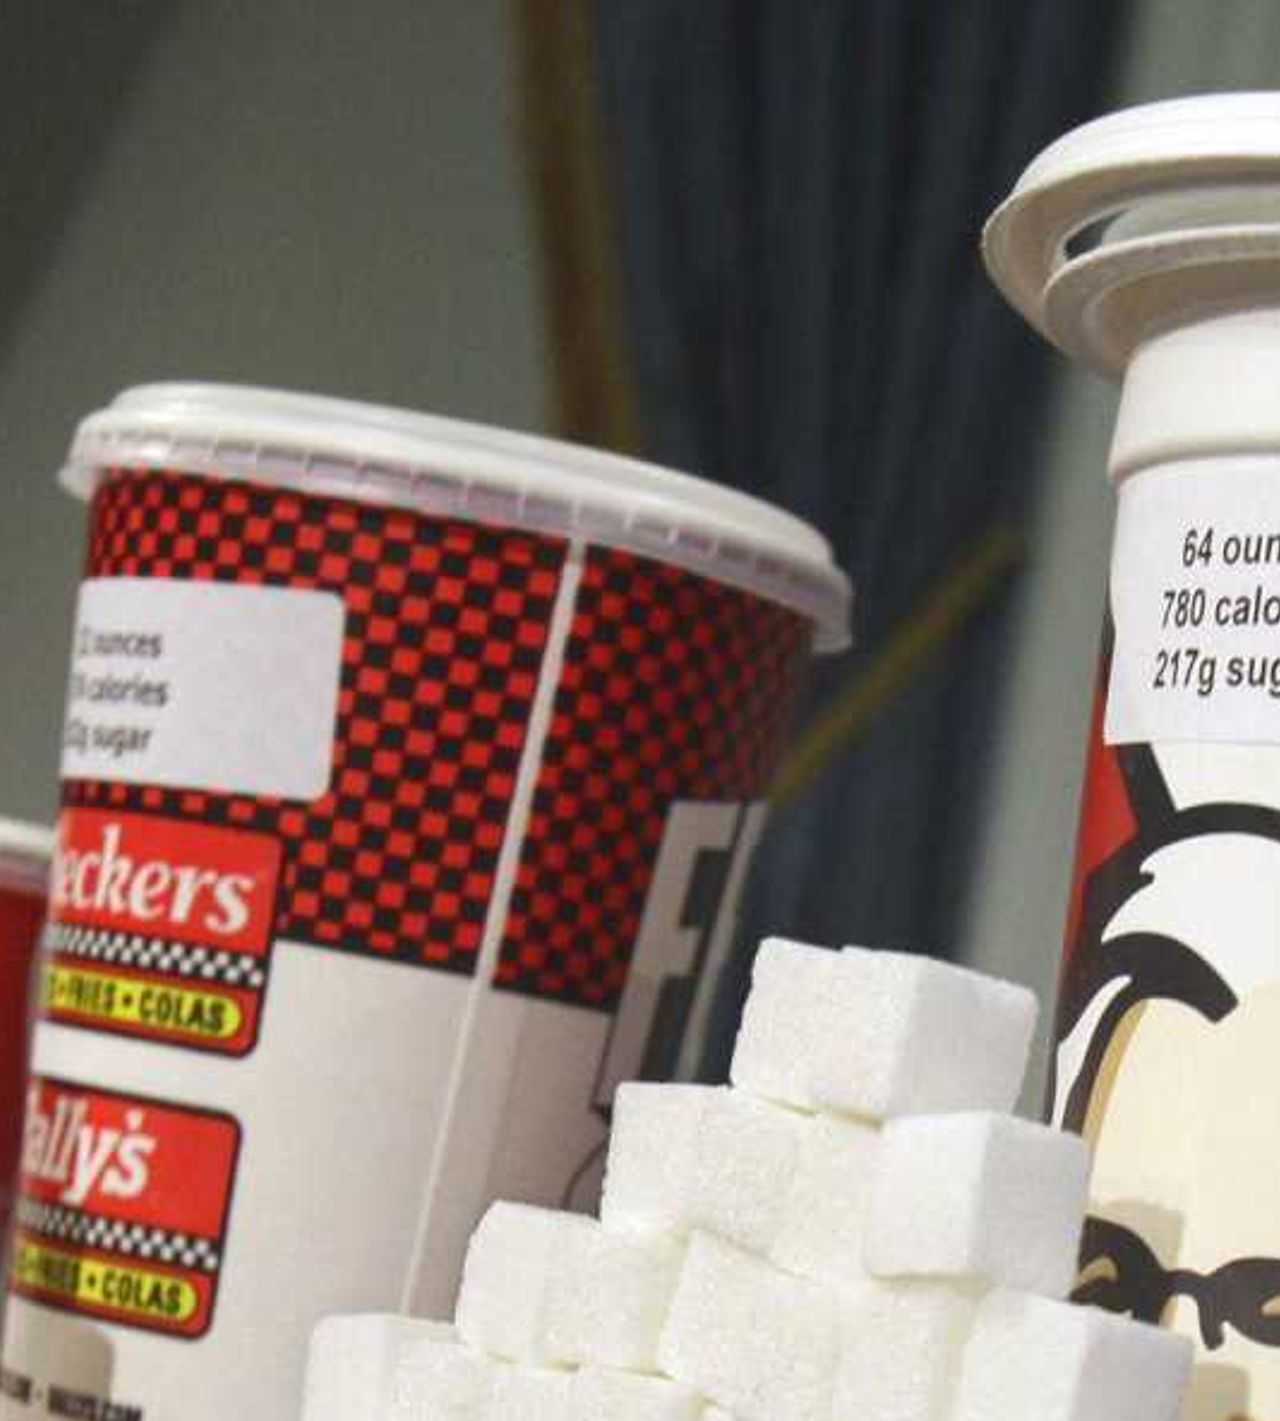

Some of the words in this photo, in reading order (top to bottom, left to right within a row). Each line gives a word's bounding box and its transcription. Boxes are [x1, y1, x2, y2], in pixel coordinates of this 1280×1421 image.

[1182, 528, 1214, 567] 64
[1162, 588, 1206, 628] 780
[1152, 649, 1217, 698] 217g
[138, 986, 226, 1035] COLAS
